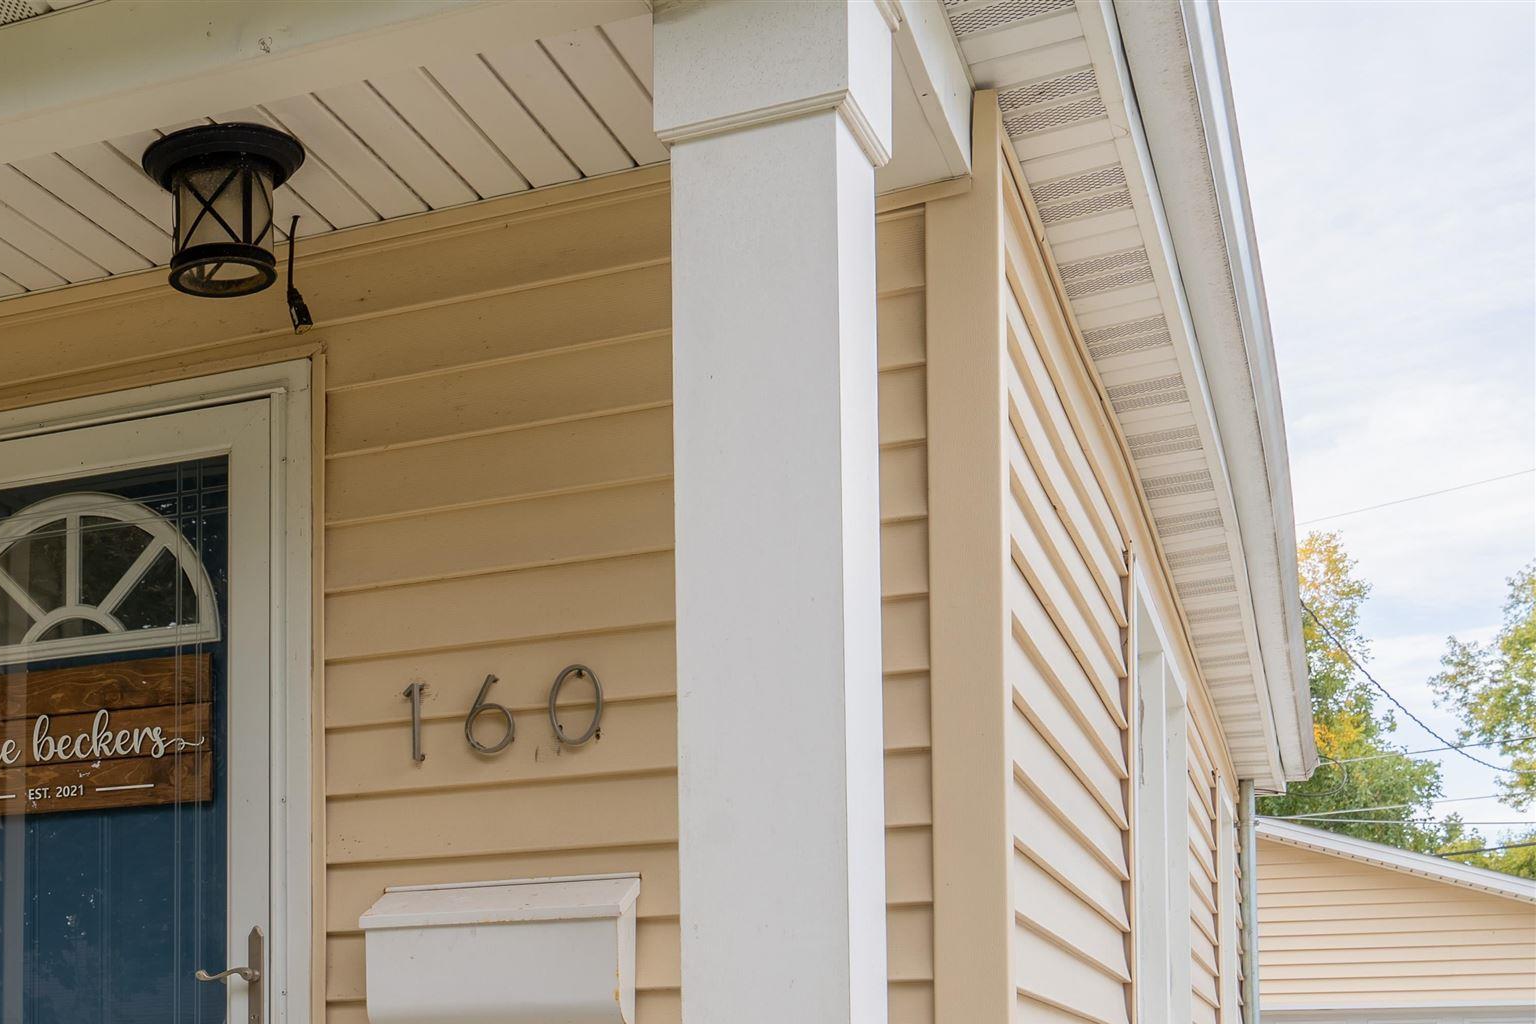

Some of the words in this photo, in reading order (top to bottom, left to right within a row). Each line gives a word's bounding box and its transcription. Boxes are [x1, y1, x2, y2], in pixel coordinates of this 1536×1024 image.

[32, 709, 204, 760] beckers
[403, 664, 603, 762] 160
[28, 787, 51, 801] EST.
[56, 784, 85, 799] 2021
